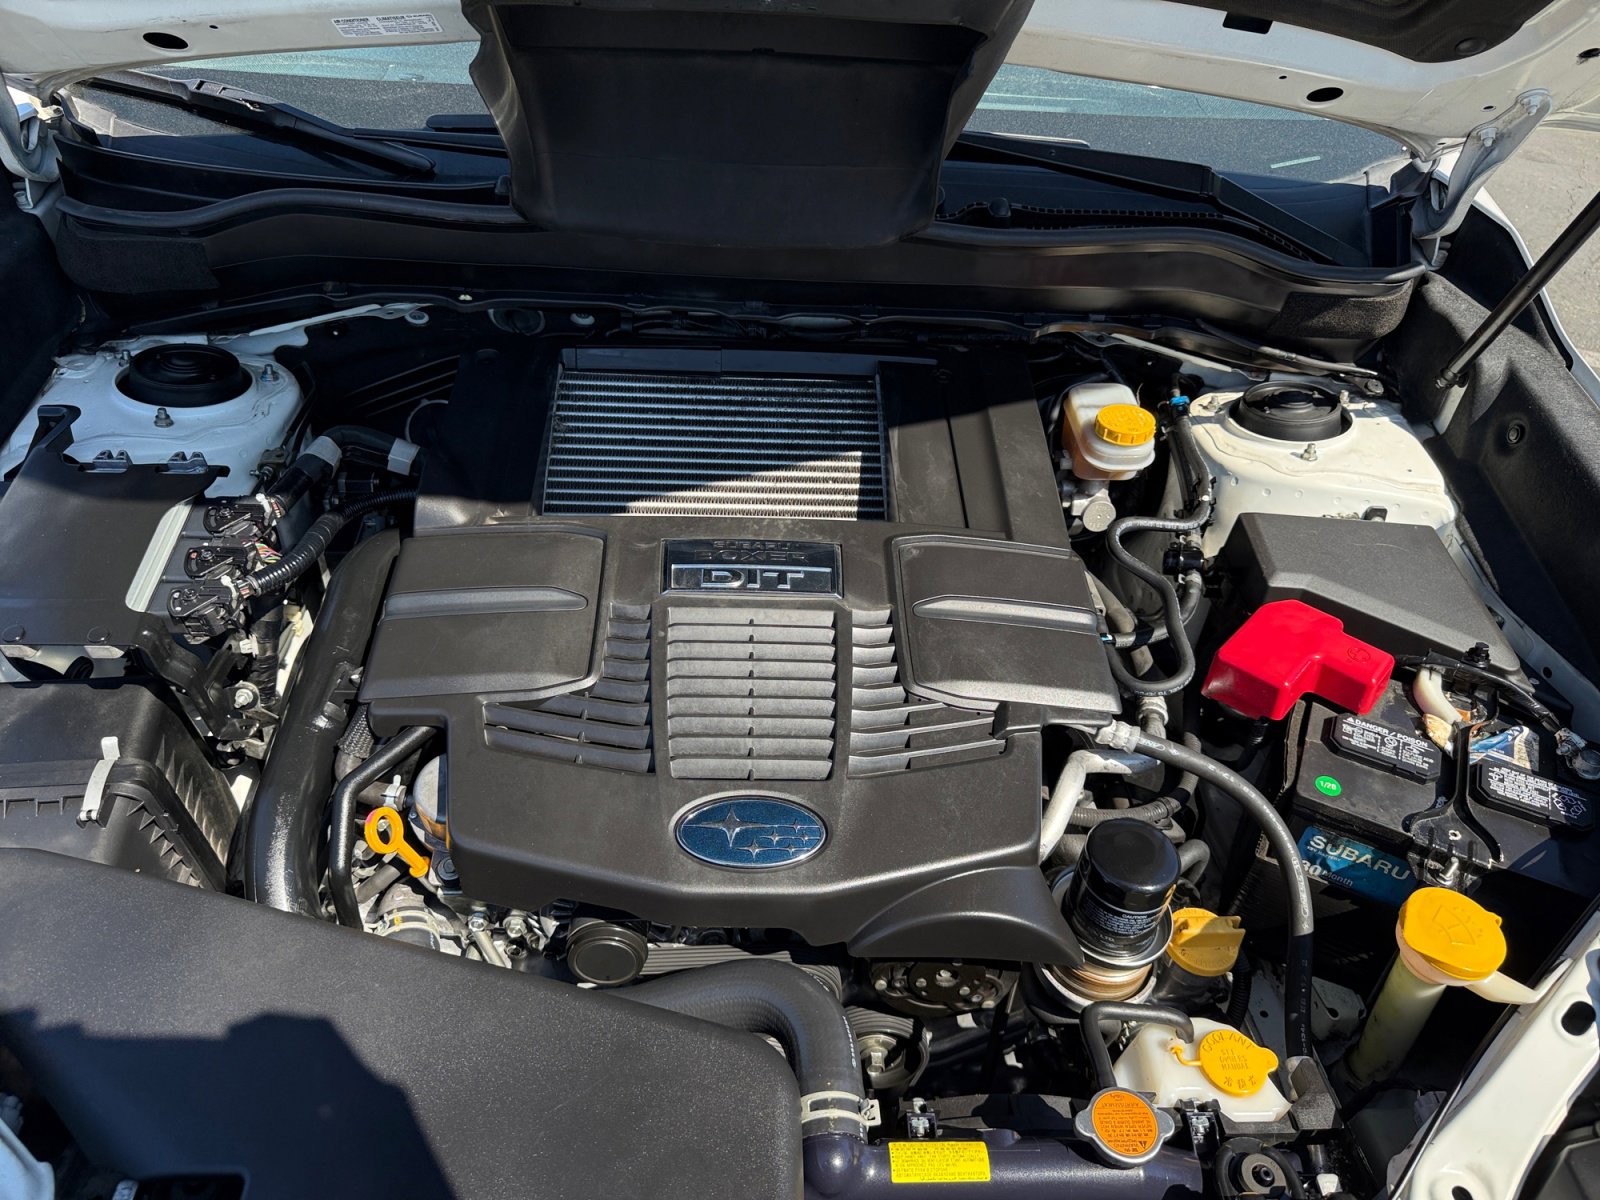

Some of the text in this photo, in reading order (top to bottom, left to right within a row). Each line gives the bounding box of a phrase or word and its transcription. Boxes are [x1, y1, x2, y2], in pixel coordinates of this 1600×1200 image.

[695, 549, 809, 563] BOXER
[700, 567, 805, 590] DIT
[1355, 718, 1390, 735] DANGER
[1396, 733, 1429, 748] POISON
[1309, 835, 1411, 880] SUBARU
[1321, 870, 1354, 887] Month
[1202, 1031, 1255, 1053] COOLANT
